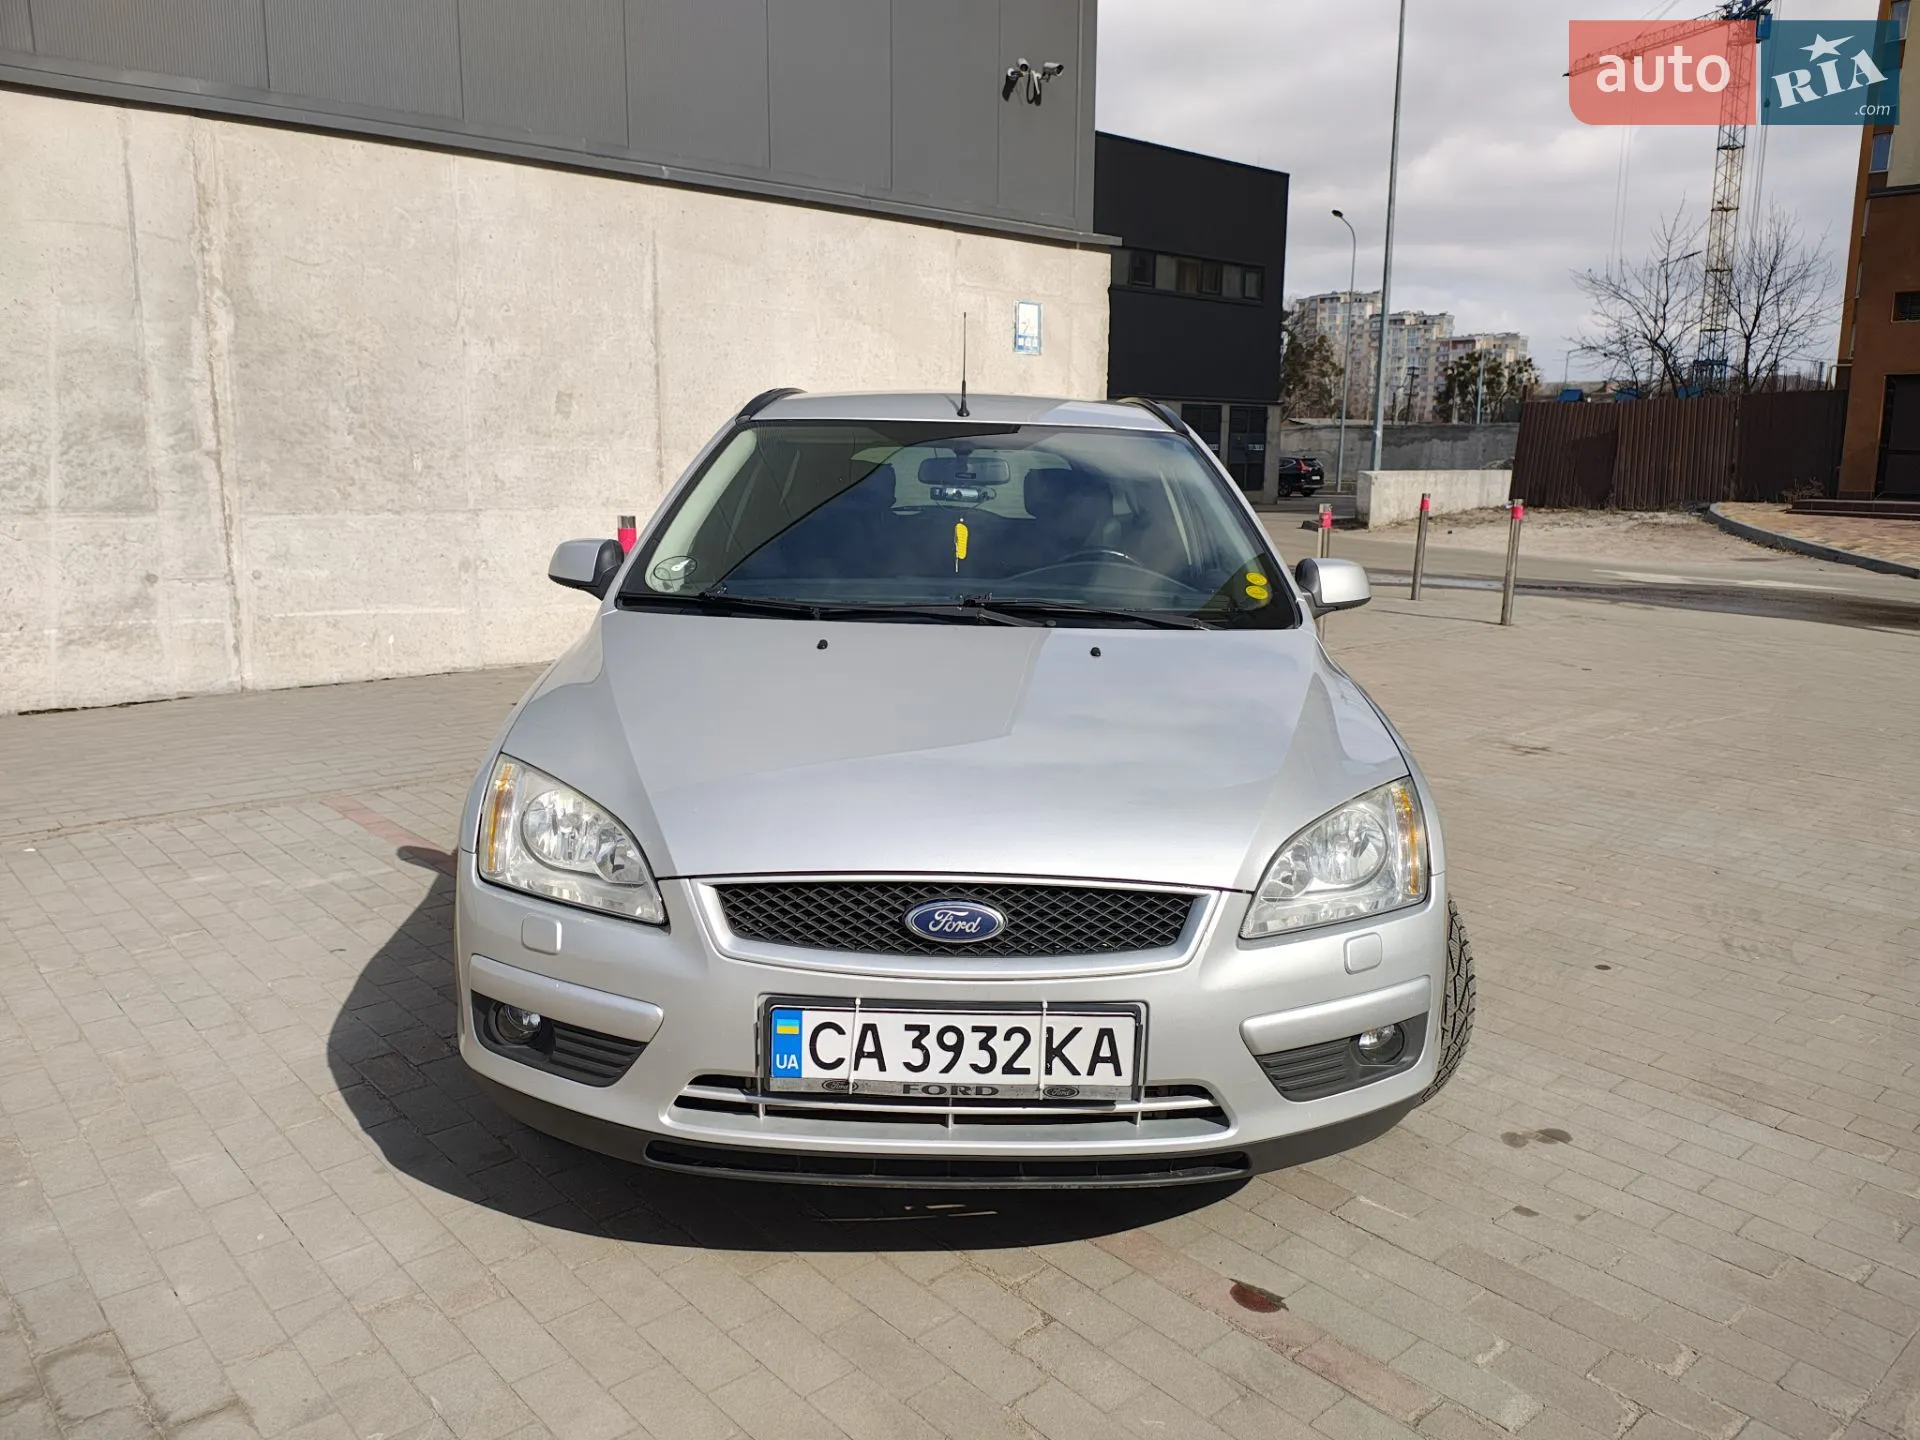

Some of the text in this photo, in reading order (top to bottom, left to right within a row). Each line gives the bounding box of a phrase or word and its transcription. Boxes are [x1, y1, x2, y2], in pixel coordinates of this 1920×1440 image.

[928, 909, 982, 933] Ford
[809, 1021, 1123, 1077] CA 3932 KA
[775, 1054, 799, 1070] UA
[902, 1084, 999, 1097] FORD
